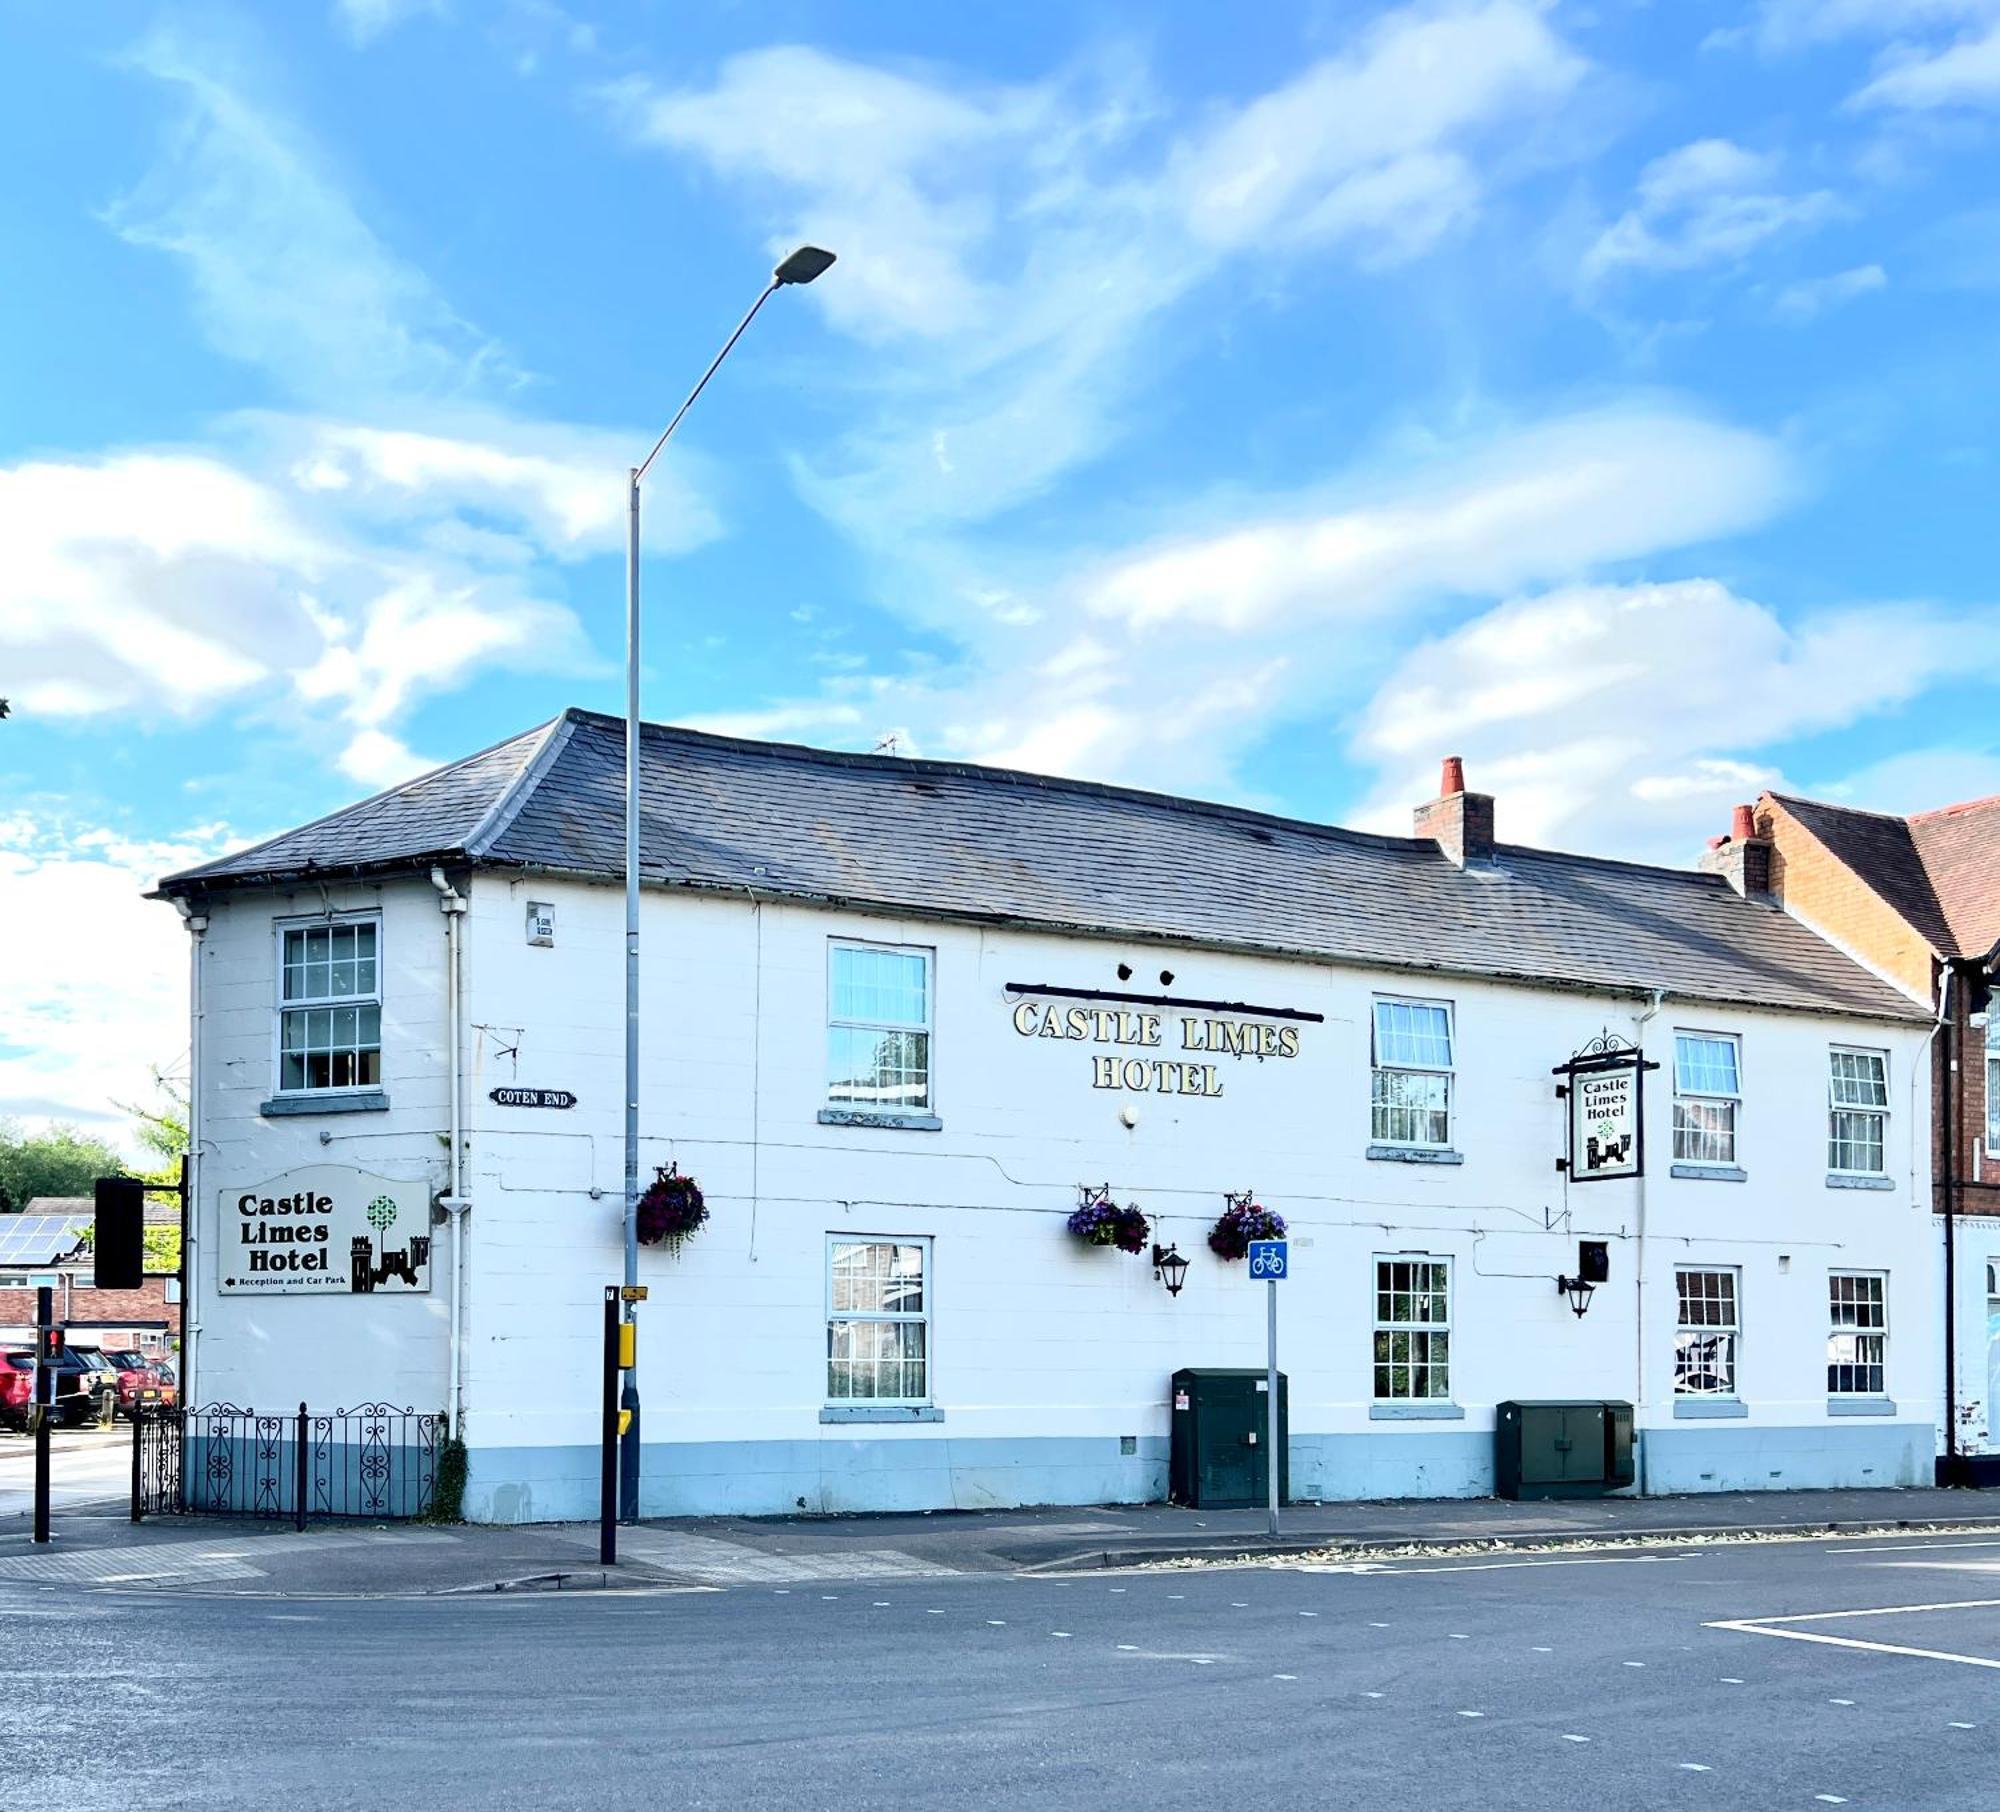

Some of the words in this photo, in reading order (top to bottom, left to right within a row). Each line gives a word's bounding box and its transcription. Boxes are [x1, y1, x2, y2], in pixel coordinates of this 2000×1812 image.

[1013, 1002, 1162, 1047] CASTLE
[1181, 1017, 1300, 1058] LIMES
[1092, 1055, 1224, 1097] HOTEL
[1583, 1079, 1628, 1094] Castle
[498, 1090, 538, 1105] COTEN
[543, 1093, 568, 1106] END
[1585, 1094, 1627, 1107] Limes
[1587, 1105, 1624, 1120] Hotel
[238, 1191, 333, 1216] Castle
[240, 1221, 329, 1244] Limes
[249, 1248, 328, 1271] Hotel
[239, 1277, 284, 1287] Reception
[286, 1277, 304, 1285] and
[306, 1277, 322, 1285] Car
[325, 1276, 346, 1284] Park
